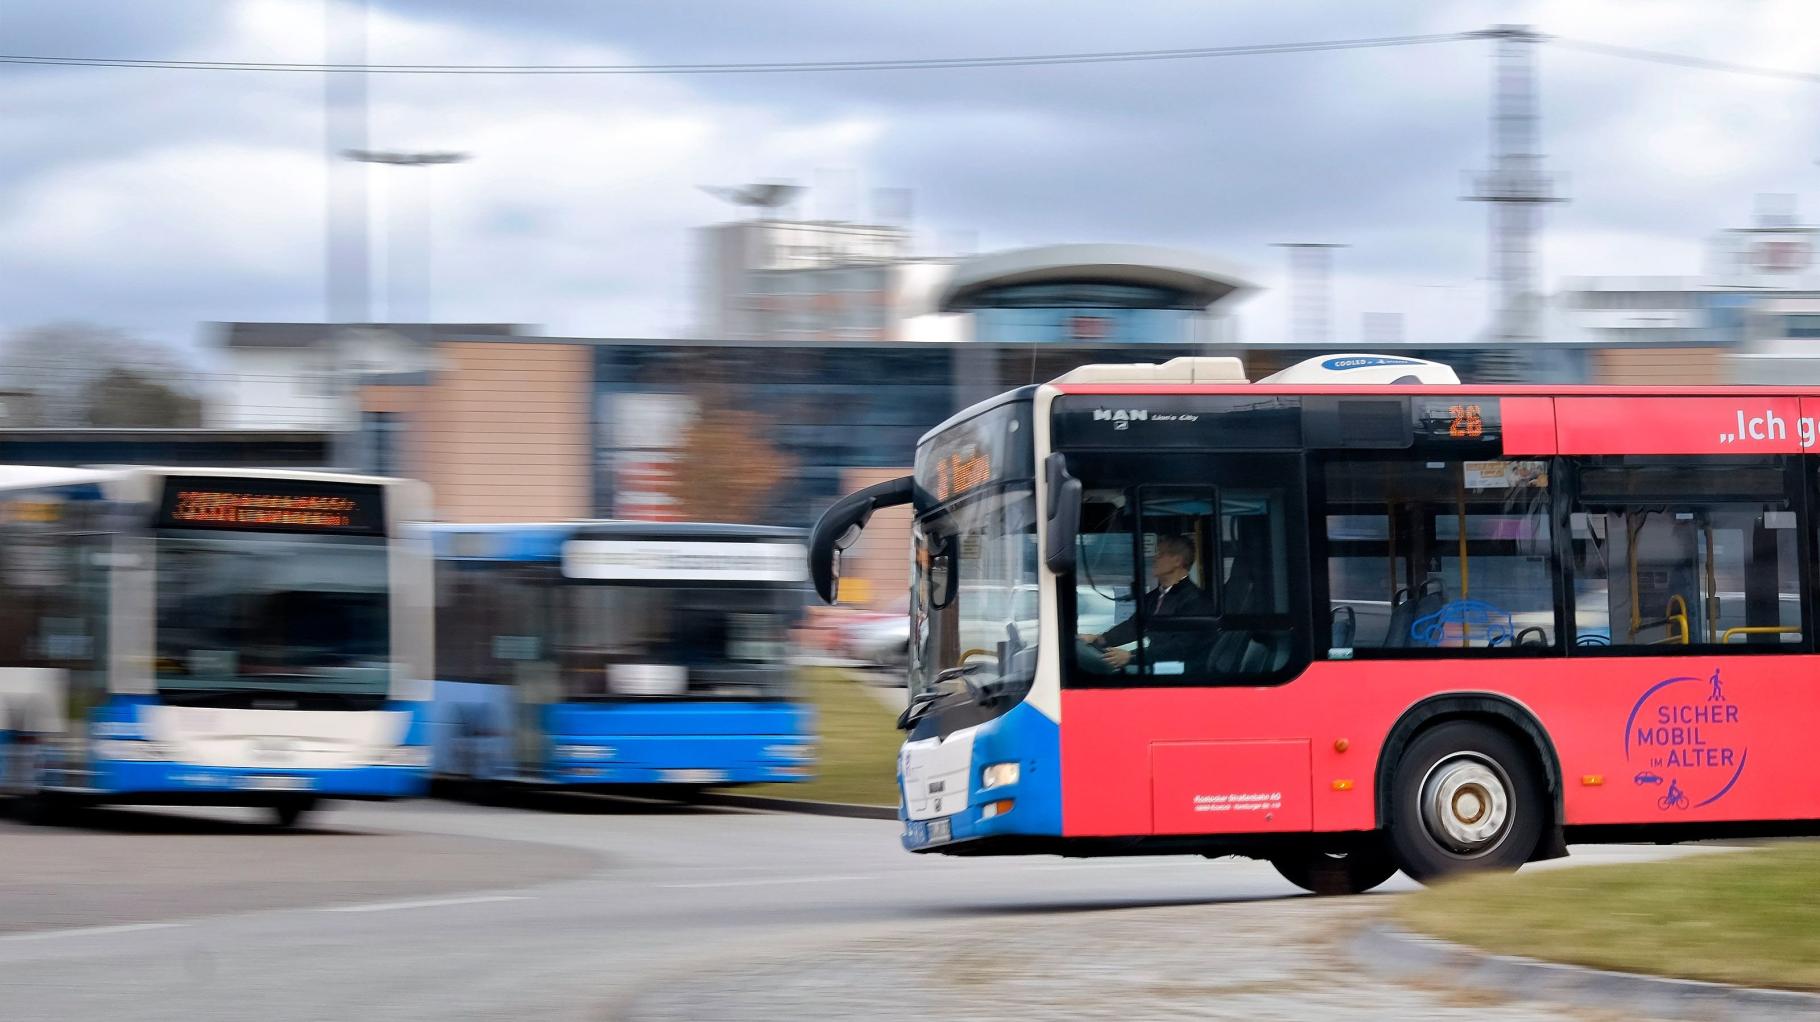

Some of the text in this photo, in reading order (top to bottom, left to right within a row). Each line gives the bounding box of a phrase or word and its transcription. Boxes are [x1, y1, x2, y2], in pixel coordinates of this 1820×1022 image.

[1093, 409, 1148, 421] MAN
[1796, 417, 1820, 448] g
[1658, 705, 1739, 724] SICHER
[1637, 727, 1706, 746] MOBIL
[1650, 748, 1734, 768] IM ALTER
